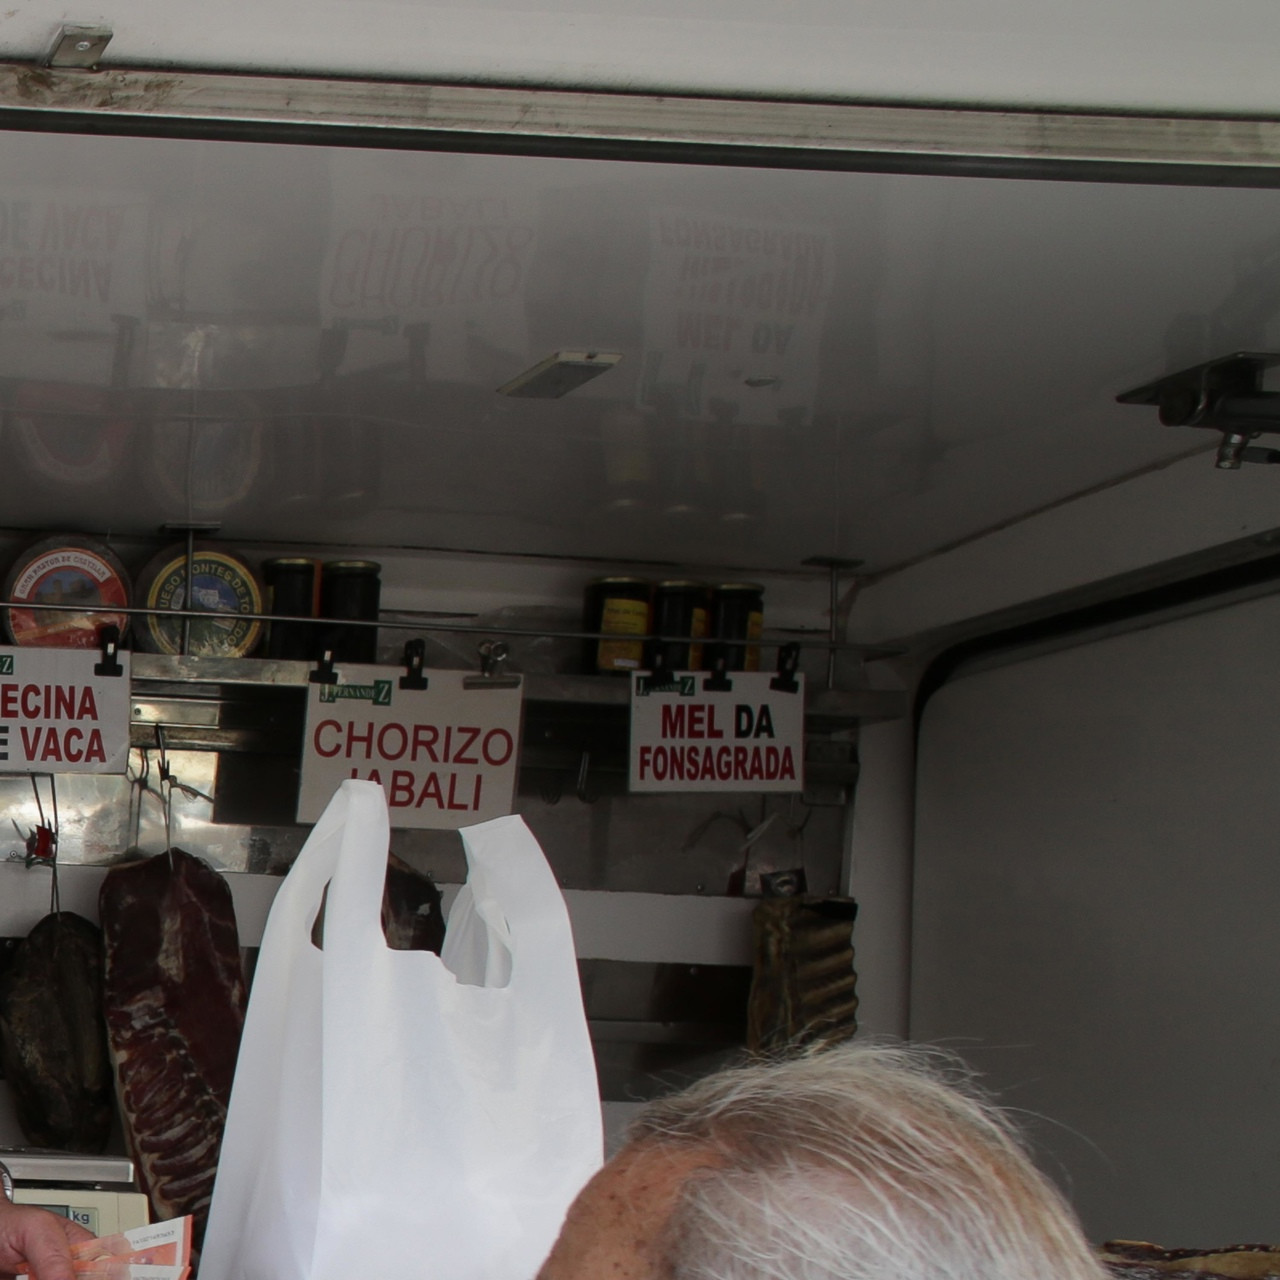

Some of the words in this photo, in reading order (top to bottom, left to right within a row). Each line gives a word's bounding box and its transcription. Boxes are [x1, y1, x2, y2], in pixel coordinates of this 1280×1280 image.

[661, 704, 724, 739] MEL
[734, 704, 775, 739] DA
[19, 726, 107, 763] VACA
[313, 719, 514, 767] CHORIZO
[639, 745, 796, 782] FONSAGRADA
[351, 768, 483, 812] BALI
[72, 1211, 90, 1225] kg
